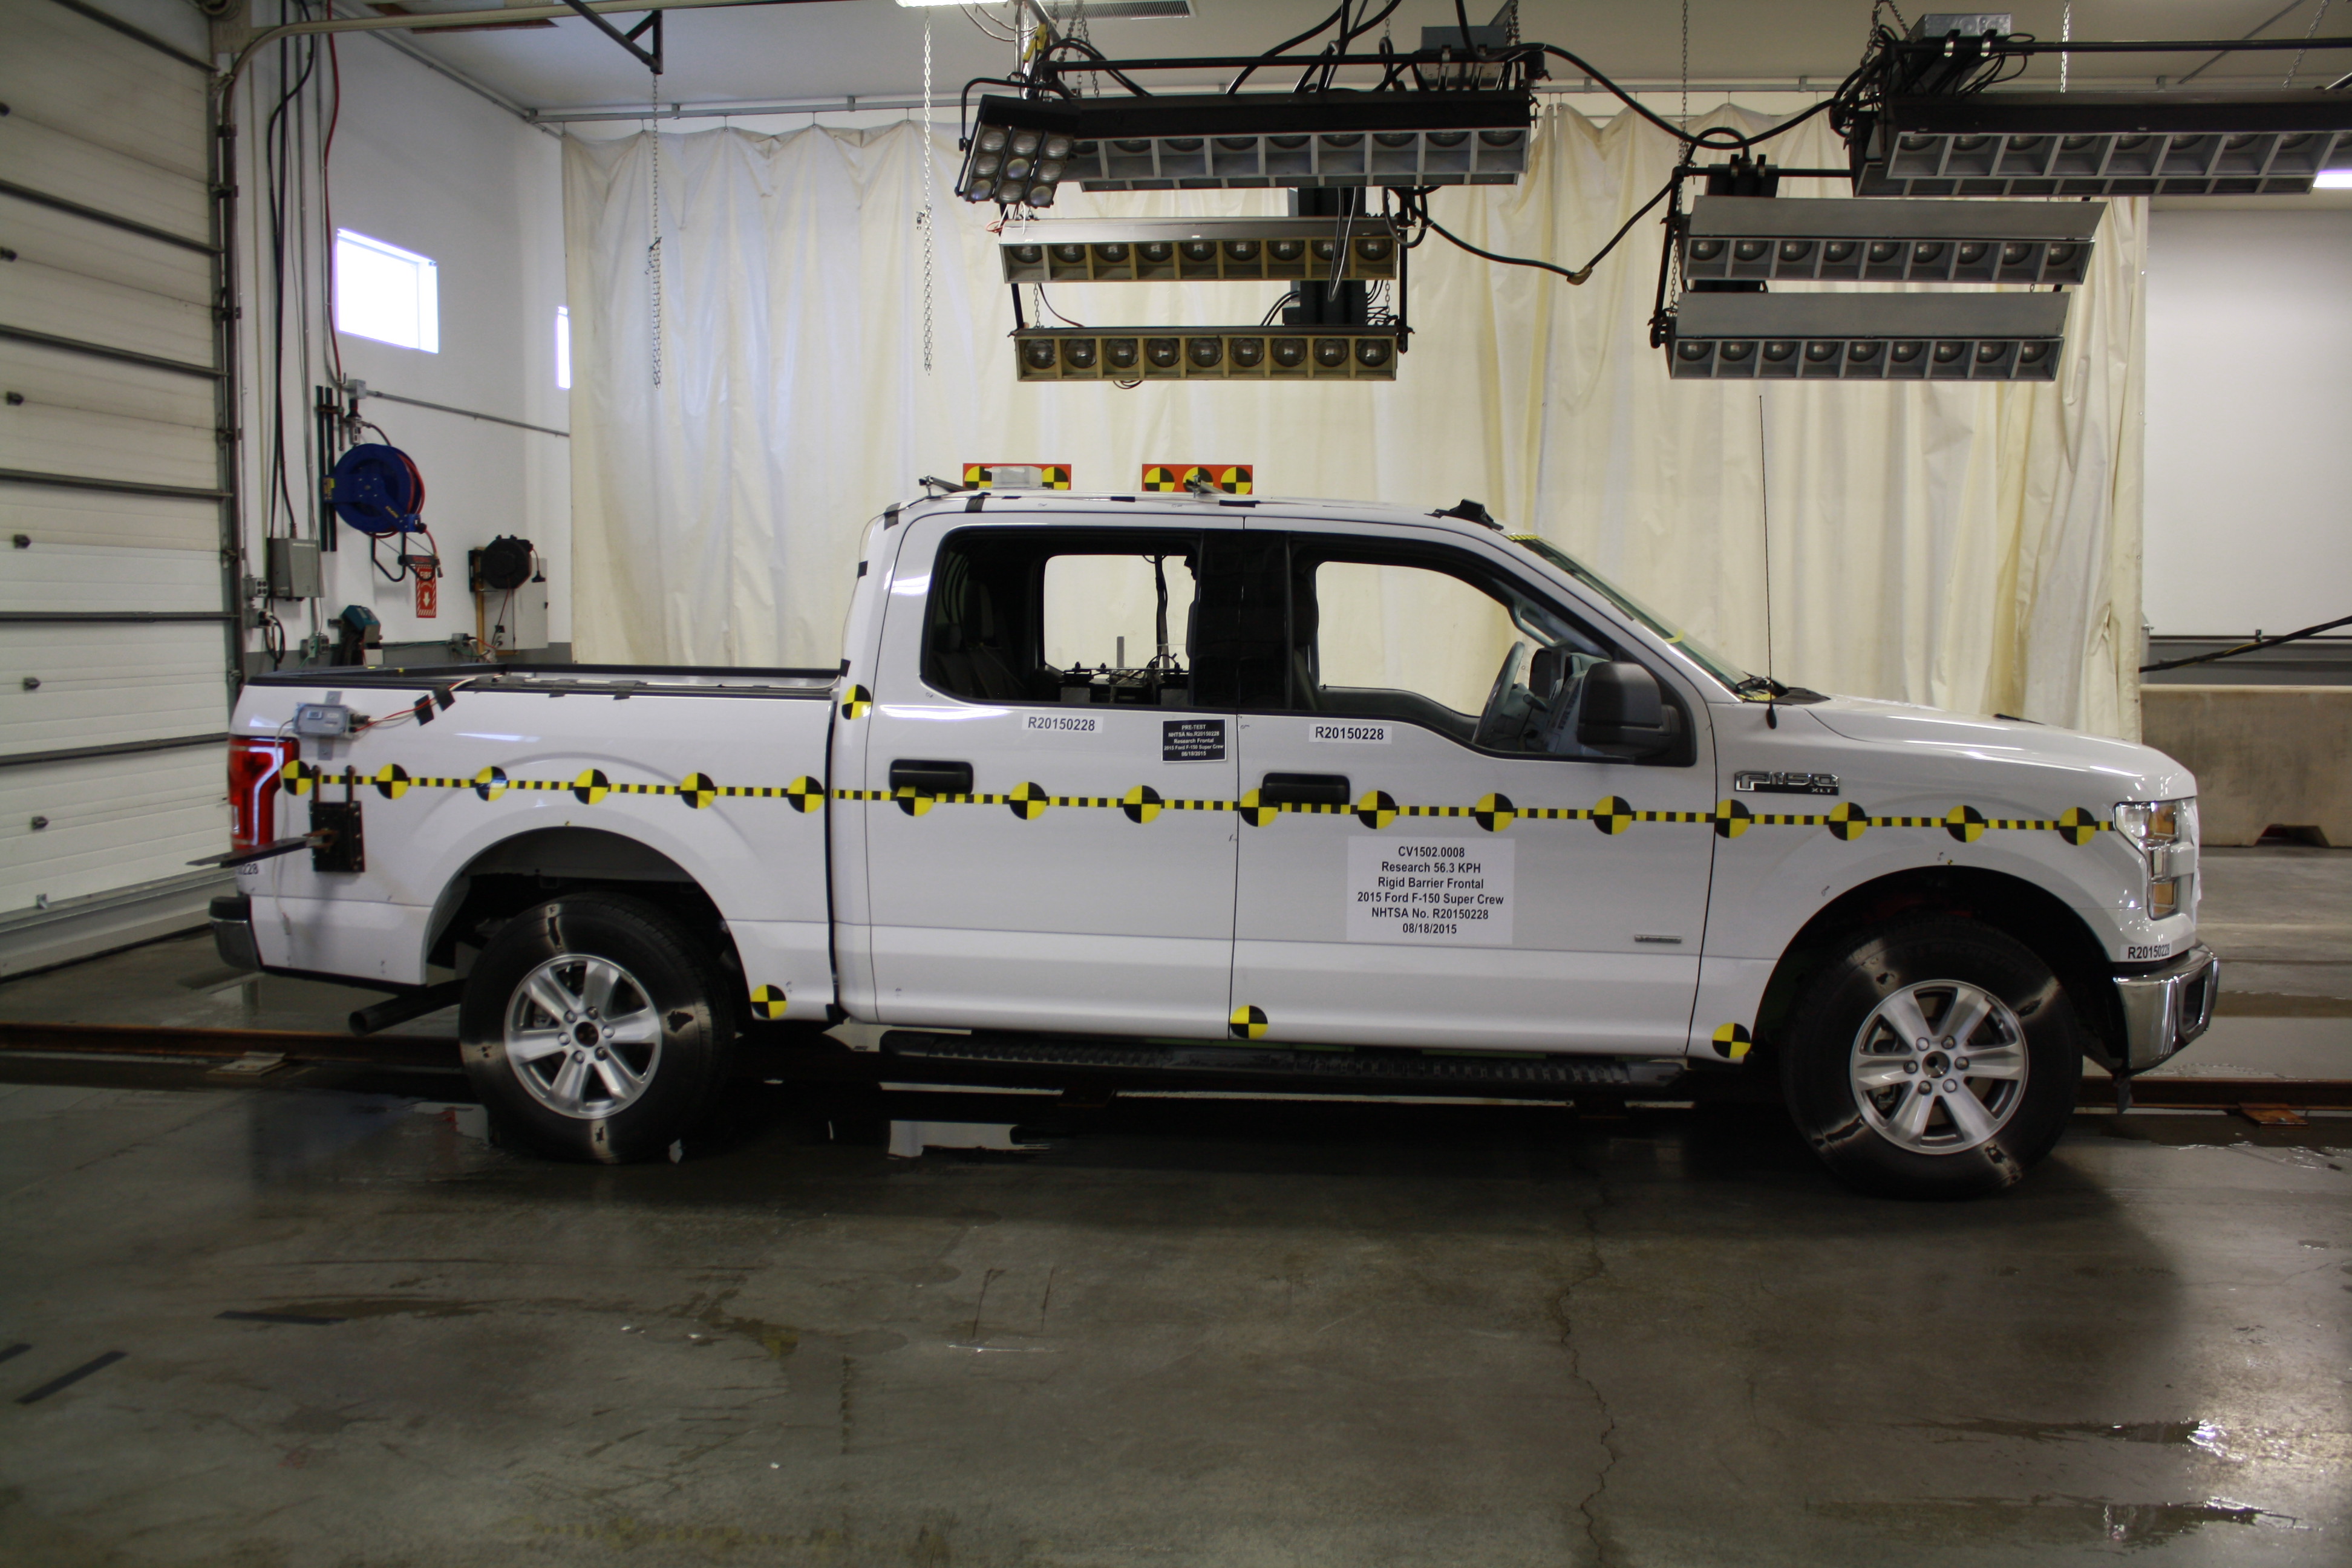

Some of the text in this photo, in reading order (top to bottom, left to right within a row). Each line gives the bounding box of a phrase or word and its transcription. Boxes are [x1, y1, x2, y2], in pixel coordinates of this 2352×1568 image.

[1028, 716, 1095, 731] R20150228
[1315, 726, 1384, 740] R20150228
[1398, 846, 1465, 858] CV1502.0008
[1382, 861, 1481, 873] Research 56.3 KPH
[1378, 877, 1484, 890] Rigid Barrier Frontal
[1357, 892, 1504, 906] 2015 Ford F-150 Super Crew
[1371, 907, 1489, 920] NHTSA No. R20150228
[1402, 923, 1457, 934] 08/18/2015
[2128, 944, 2170, 958] R20150228
